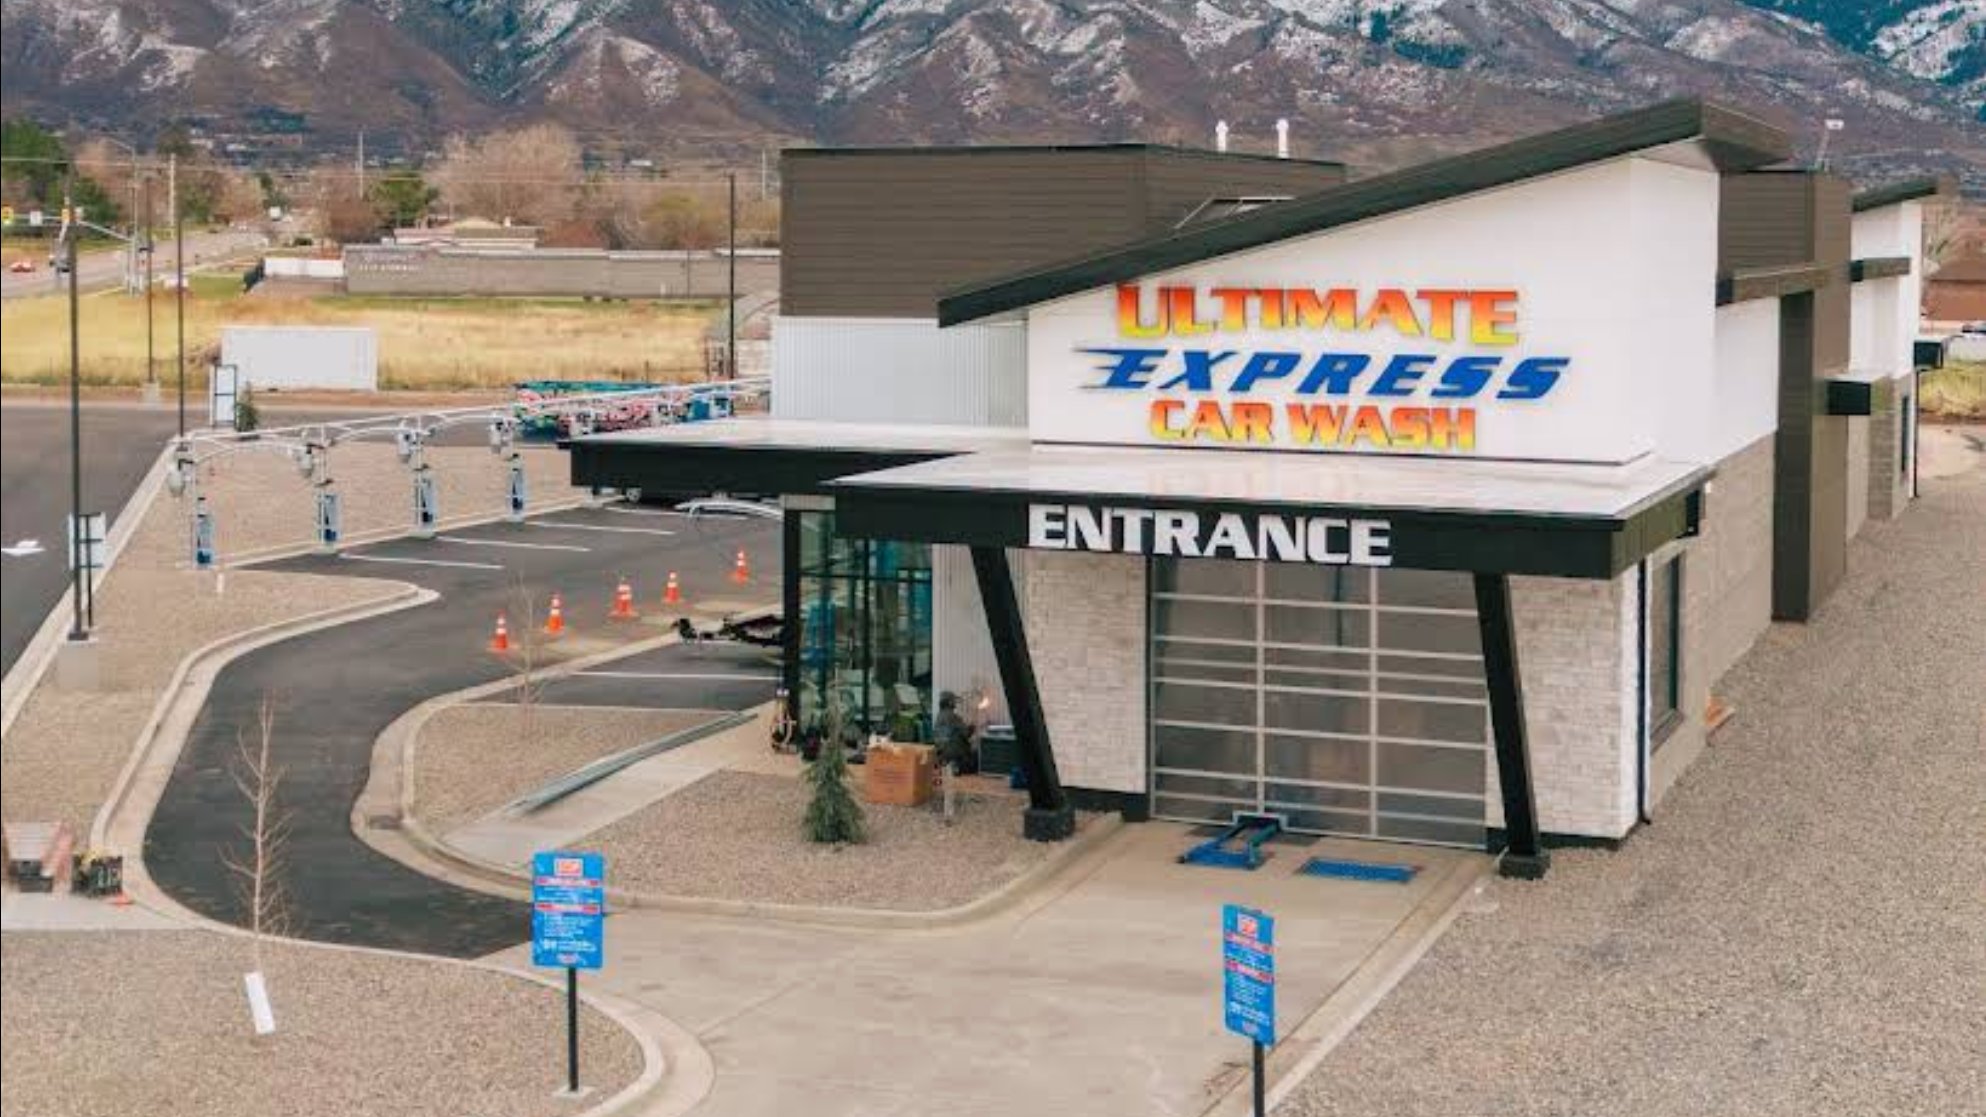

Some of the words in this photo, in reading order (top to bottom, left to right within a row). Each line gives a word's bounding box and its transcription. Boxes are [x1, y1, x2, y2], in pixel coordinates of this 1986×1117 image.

[1117, 284, 1518, 346] ULTIMATE
[1076, 348, 1571, 399] EXPRESS
[1149, 400, 1275, 444] CAR
[1287, 403, 1477, 451] WASH
[1028, 504, 1392, 566] ENTRANCE
